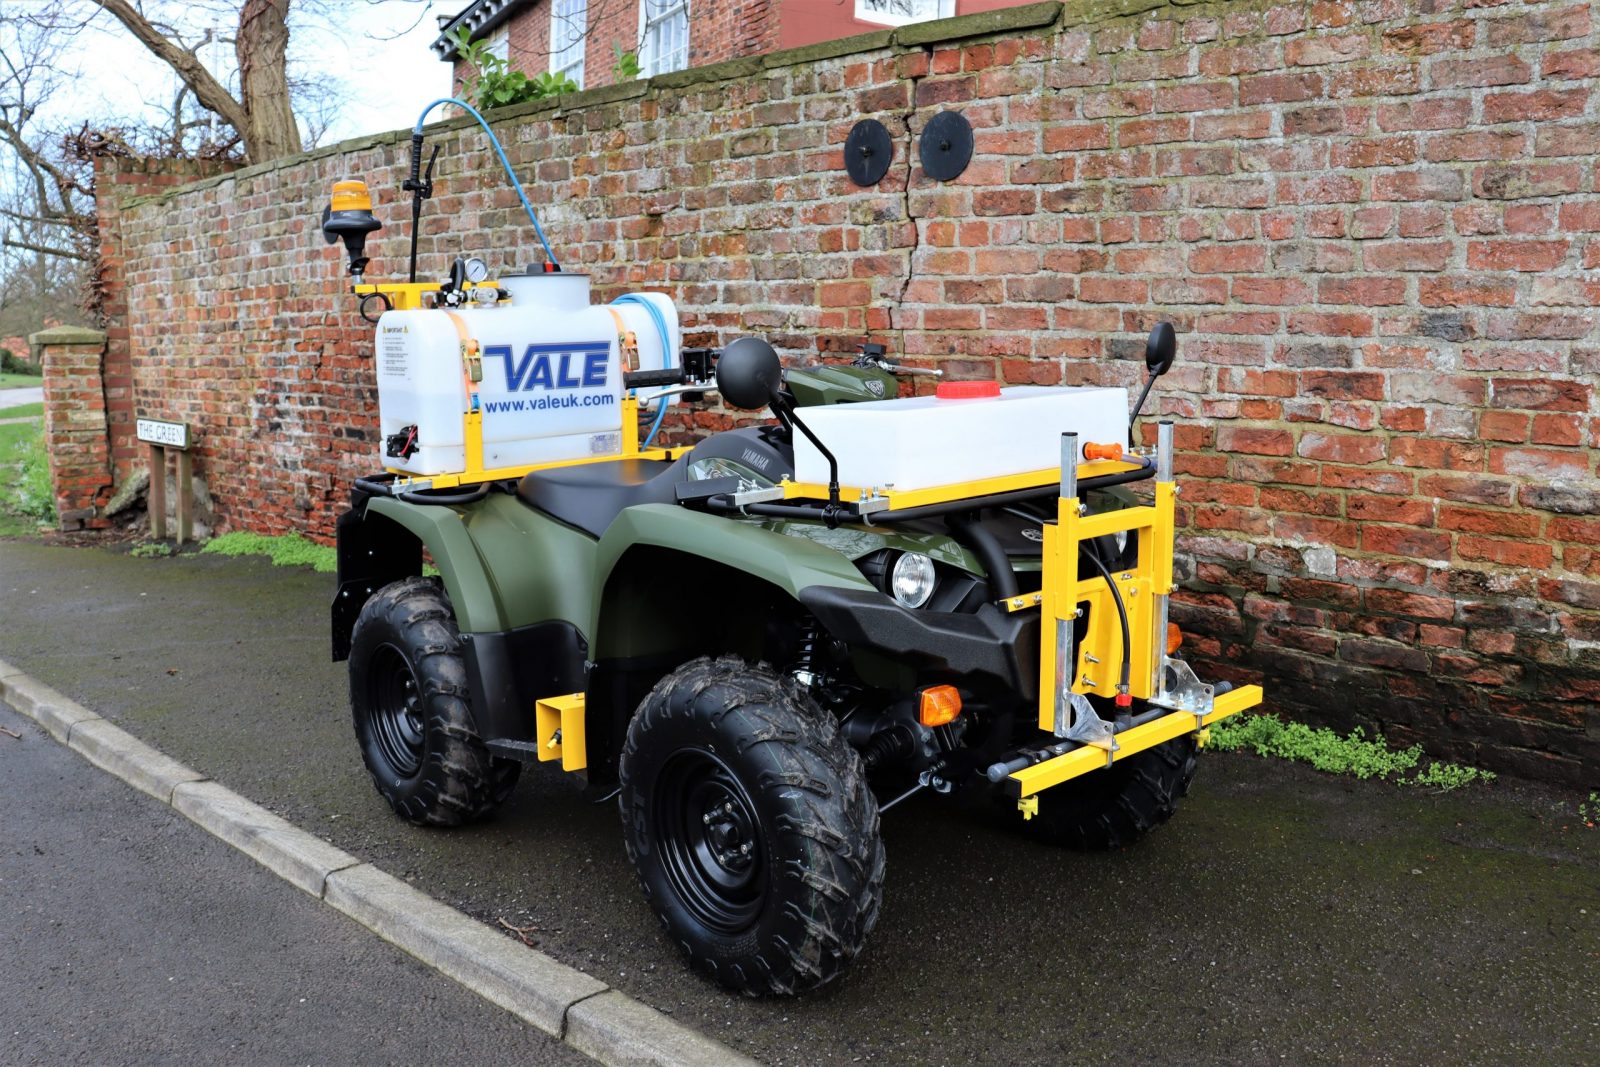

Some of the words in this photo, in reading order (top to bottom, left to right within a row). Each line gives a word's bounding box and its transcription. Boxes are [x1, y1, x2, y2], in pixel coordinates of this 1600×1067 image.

[483, 340, 611, 392] VALE
[485, 393, 614, 413] www.valeuk.com
[139, 422, 153, 438] THE
[156, 424, 183, 442] GREEN
[741, 448, 769, 470] YAMAHA
